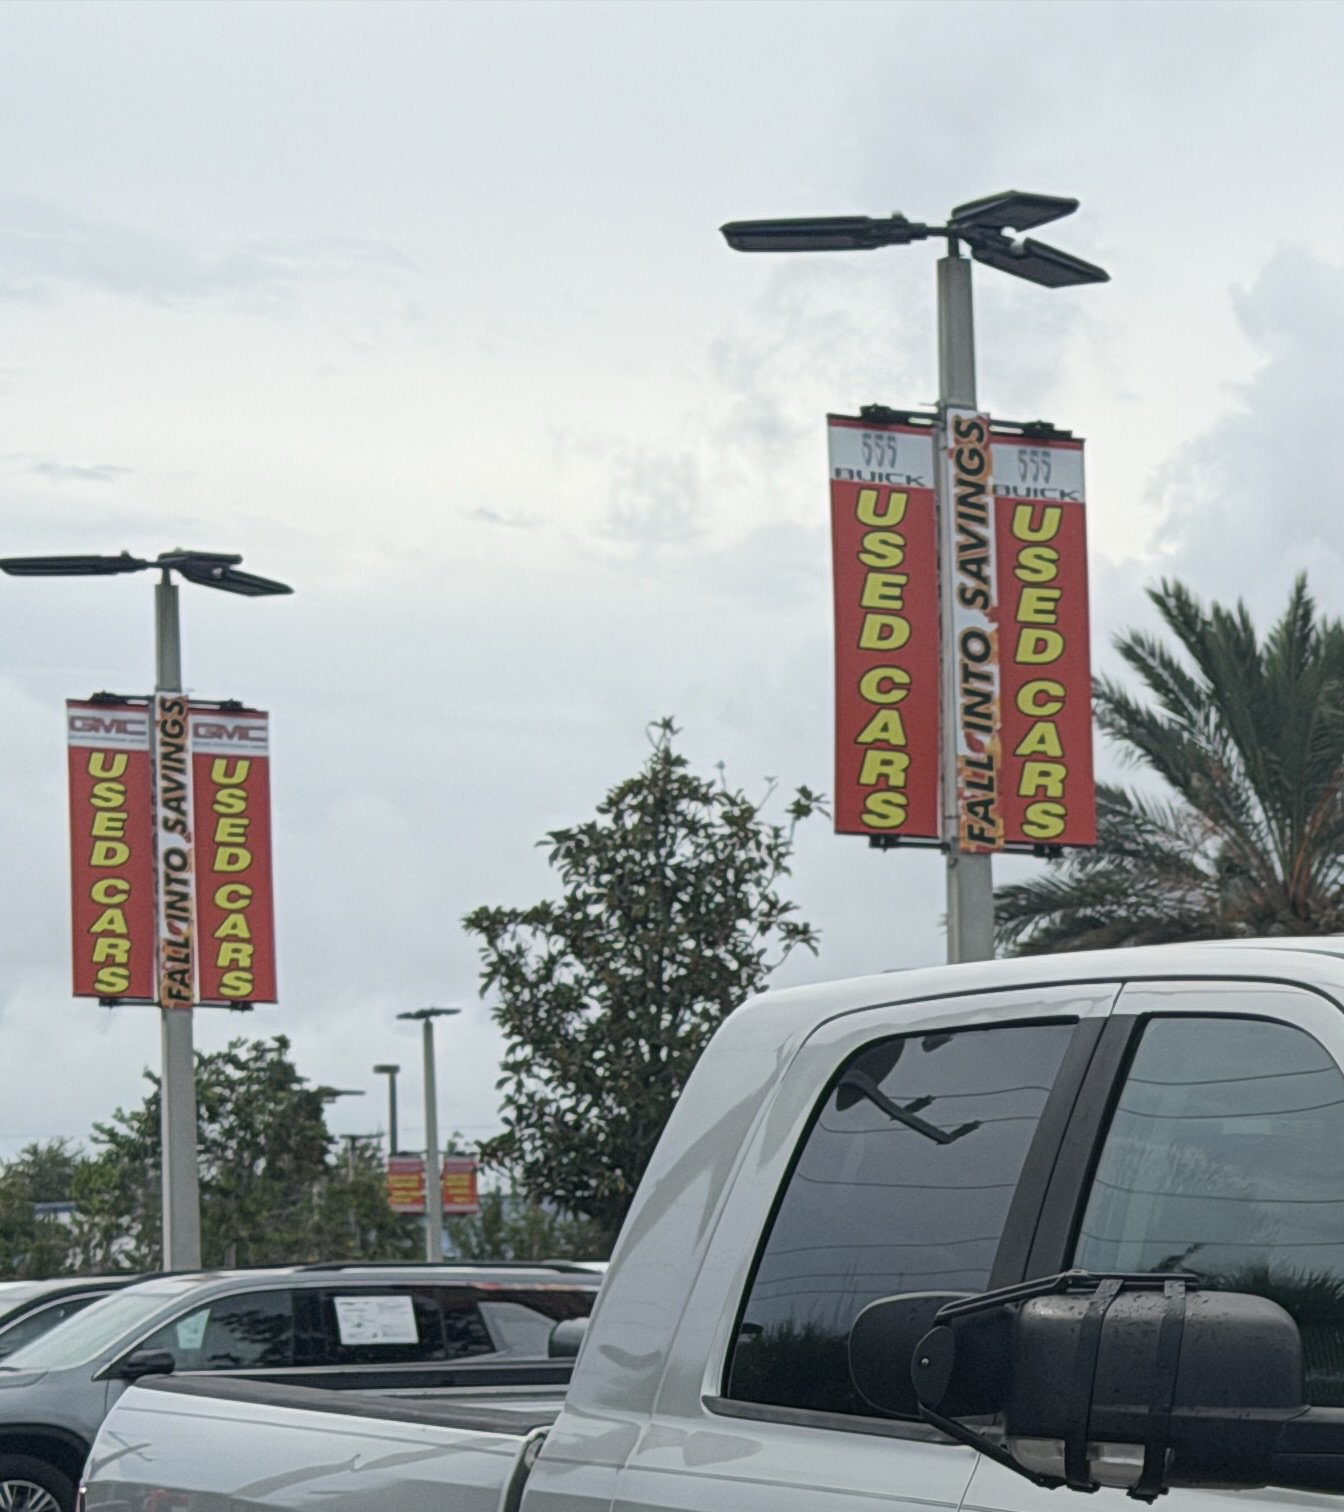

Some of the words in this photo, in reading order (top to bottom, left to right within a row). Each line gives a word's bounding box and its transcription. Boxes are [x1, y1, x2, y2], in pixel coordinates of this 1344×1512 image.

[855, 487, 912, 652] USED
[953, 415, 992, 611] SAVINGS
[1009, 502, 1066, 666] USED
[69, 715, 147, 737] GMC
[192, 722, 267, 742] GMC
[960, 627, 994, 735] INTO
[160, 698, 188, 839] SAVINGS
[853, 664, 913, 830] CARS
[963, 754, 997, 845] FALL
[1012, 677, 1069, 840] CARS
[87, 751, 130, 868] USED
[210, 757, 253, 873] USED
[88, 878, 132, 995] CARS
[163, 847, 190, 922] INTO
[212, 883, 255, 998] CARS
[164, 937, 191, 1002] FALL
